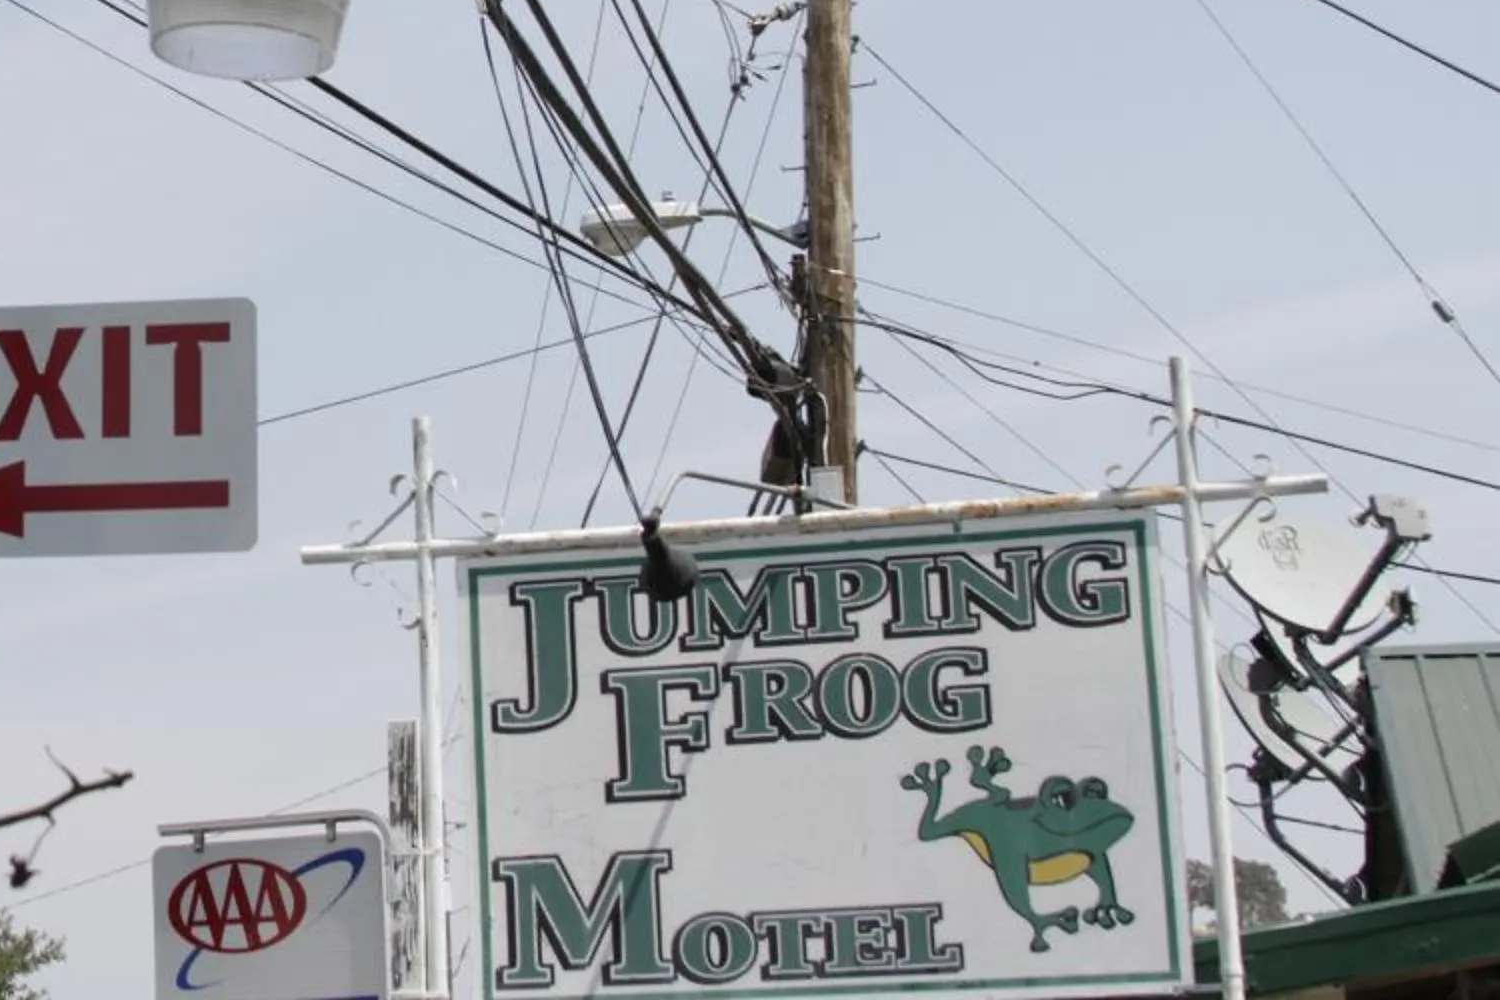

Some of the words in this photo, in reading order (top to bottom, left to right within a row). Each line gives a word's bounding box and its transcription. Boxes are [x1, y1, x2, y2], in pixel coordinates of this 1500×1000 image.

[491, 541, 1132, 734] JUMPING
[600, 646, 992, 804] FROG
[180, 859, 297, 952] AAA
[493, 849, 964, 989] MOTEL
